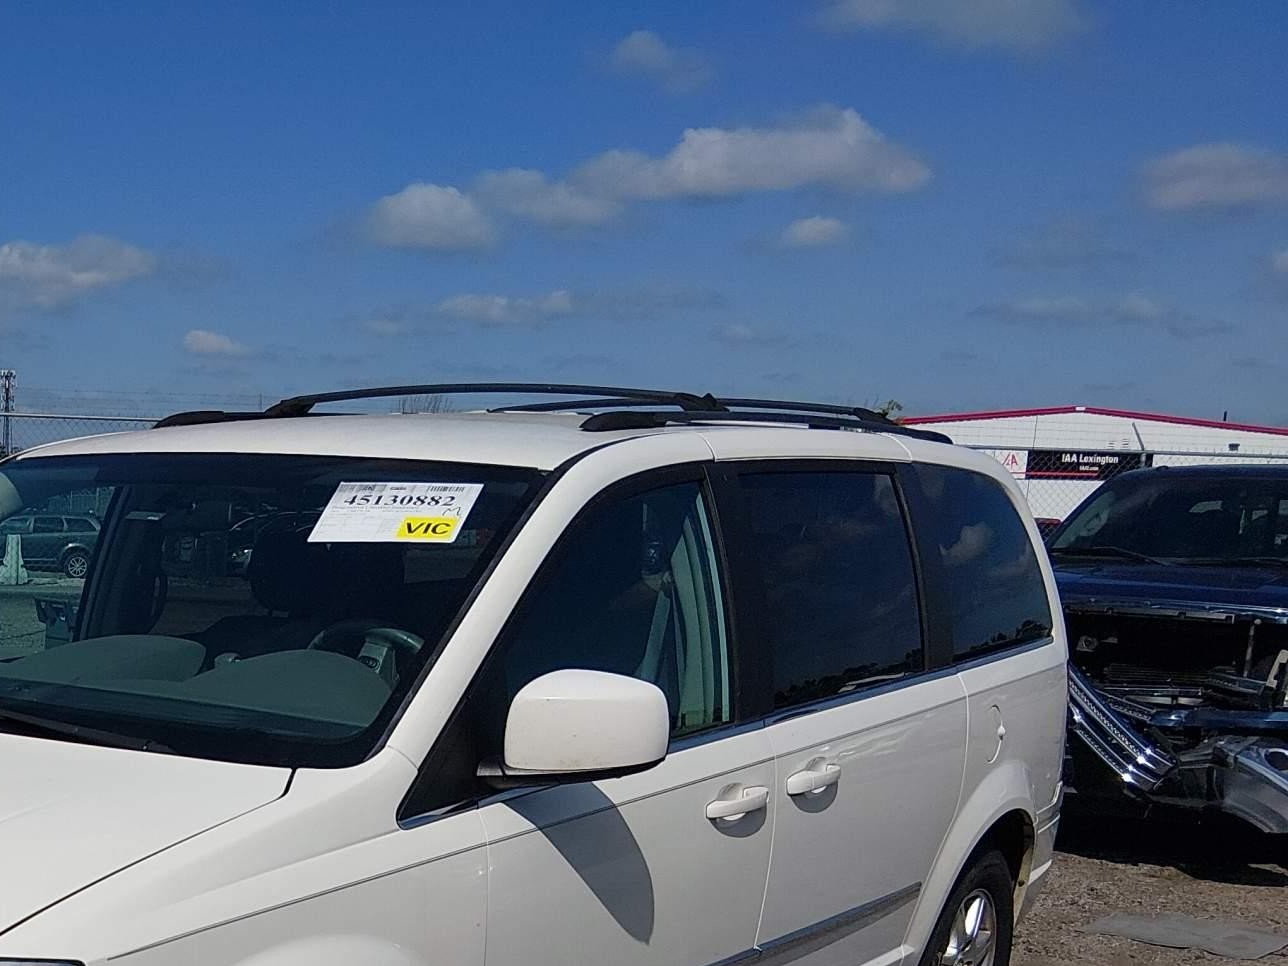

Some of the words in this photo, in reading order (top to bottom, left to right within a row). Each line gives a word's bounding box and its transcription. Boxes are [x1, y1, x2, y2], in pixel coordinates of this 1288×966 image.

[1062, 453, 1078, 463] IAA
[1079, 454, 1119, 465] Lexington
[344, 494, 456, 507] 45130882
[405, 522, 452, 536] VIC
